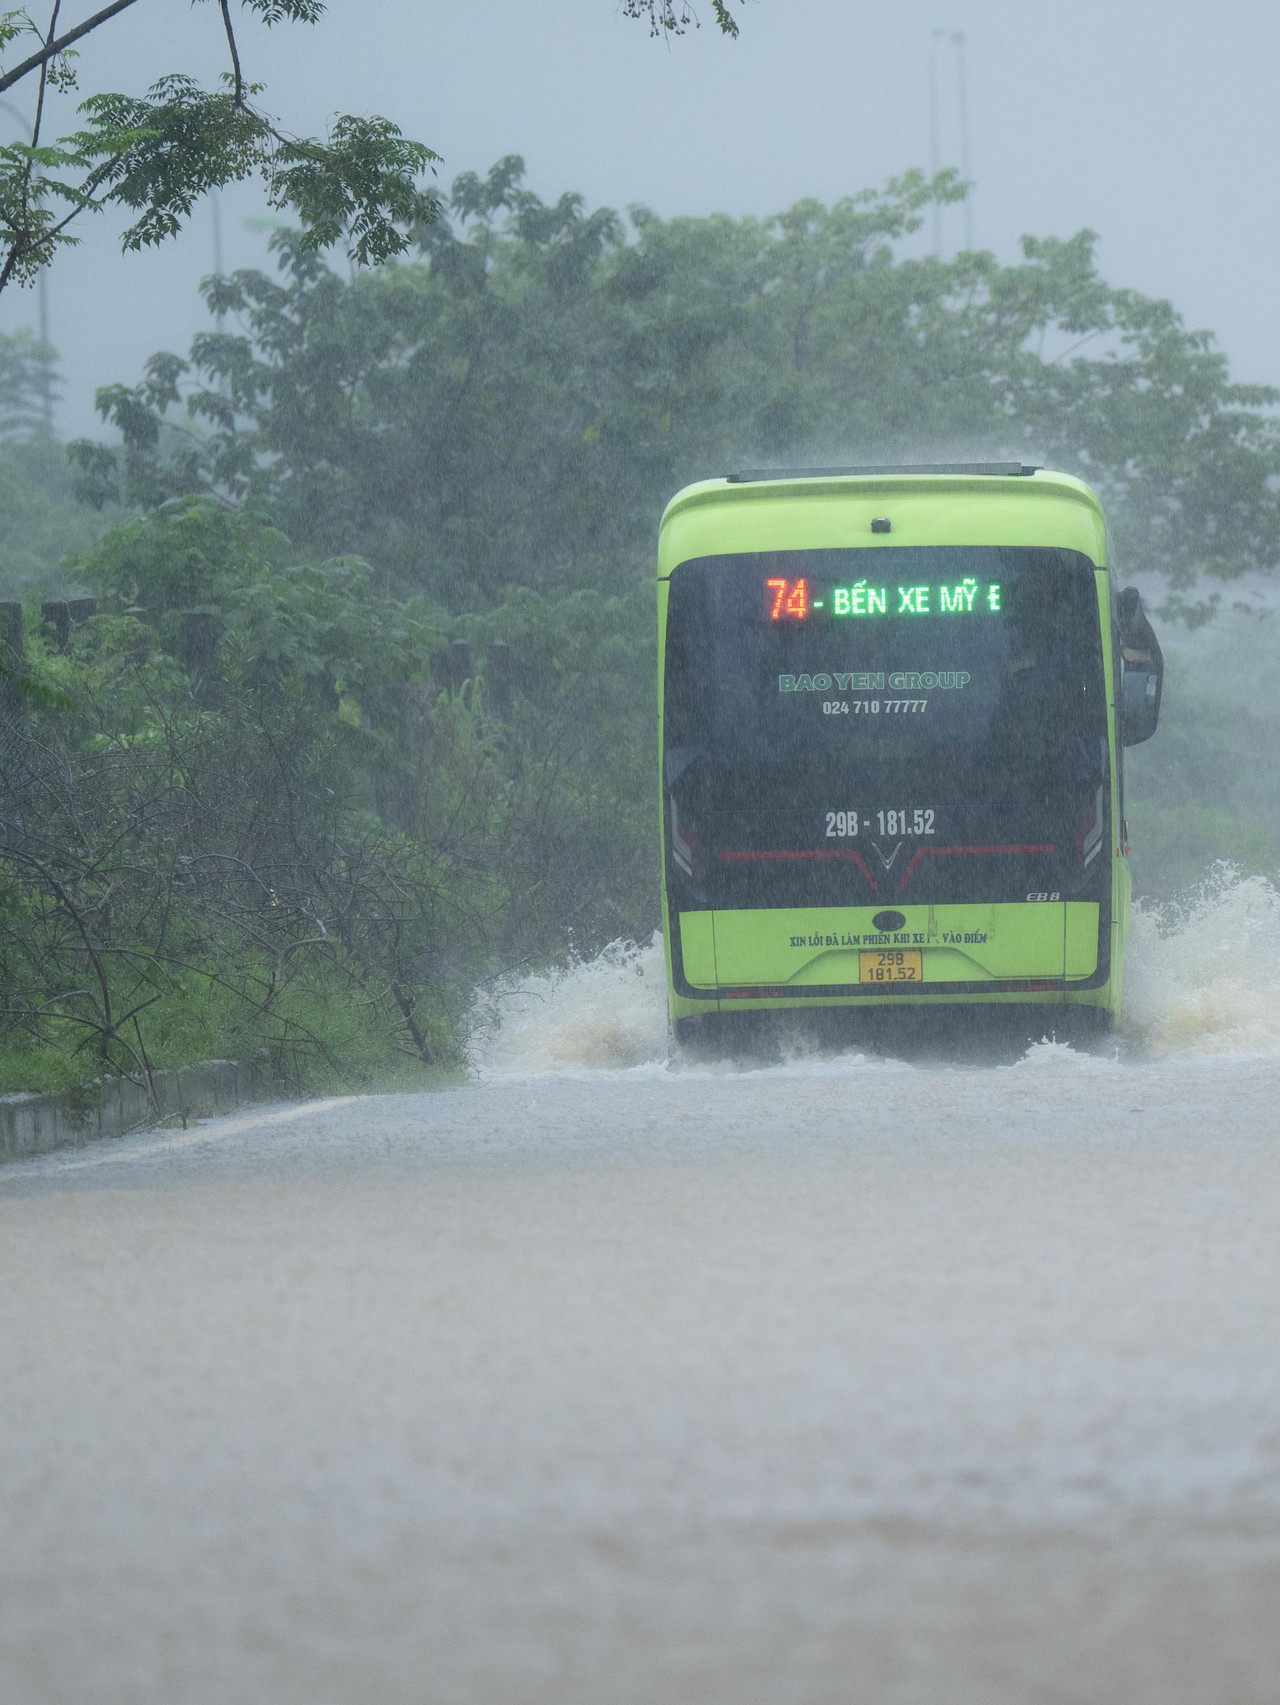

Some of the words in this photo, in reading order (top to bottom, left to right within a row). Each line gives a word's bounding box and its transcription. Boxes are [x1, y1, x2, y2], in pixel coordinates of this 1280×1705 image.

[767, 578, 807, 620] 74
[834, 579, 886, 615] BẾN
[899, 586, 930, 613] XE
[940, 578, 978, 612] MỸ
[779, 673, 832, 691] BAO
[833, 672, 885, 690] YEN
[888, 671, 971, 690] GROUP
[822, 701, 849, 715] 024
[853, 700, 880, 714] 710
[884, 699, 928, 714] 77777
[825, 810, 858, 837] 29B
[877, 809, 935, 836] 181.52
[789, 936, 806, 947] XIN
[808, 931, 824, 946] LỖI
[825, 932, 839, 946] ĐÃ
[841, 932, 860, 945] LÀM
[893, 933, 910, 944] KHI
[913, 933, 925, 944] XE
[942, 930, 962, 943] VÀO
[877, 952, 904, 966] 29B
[868, 967, 916, 981] 181.52
